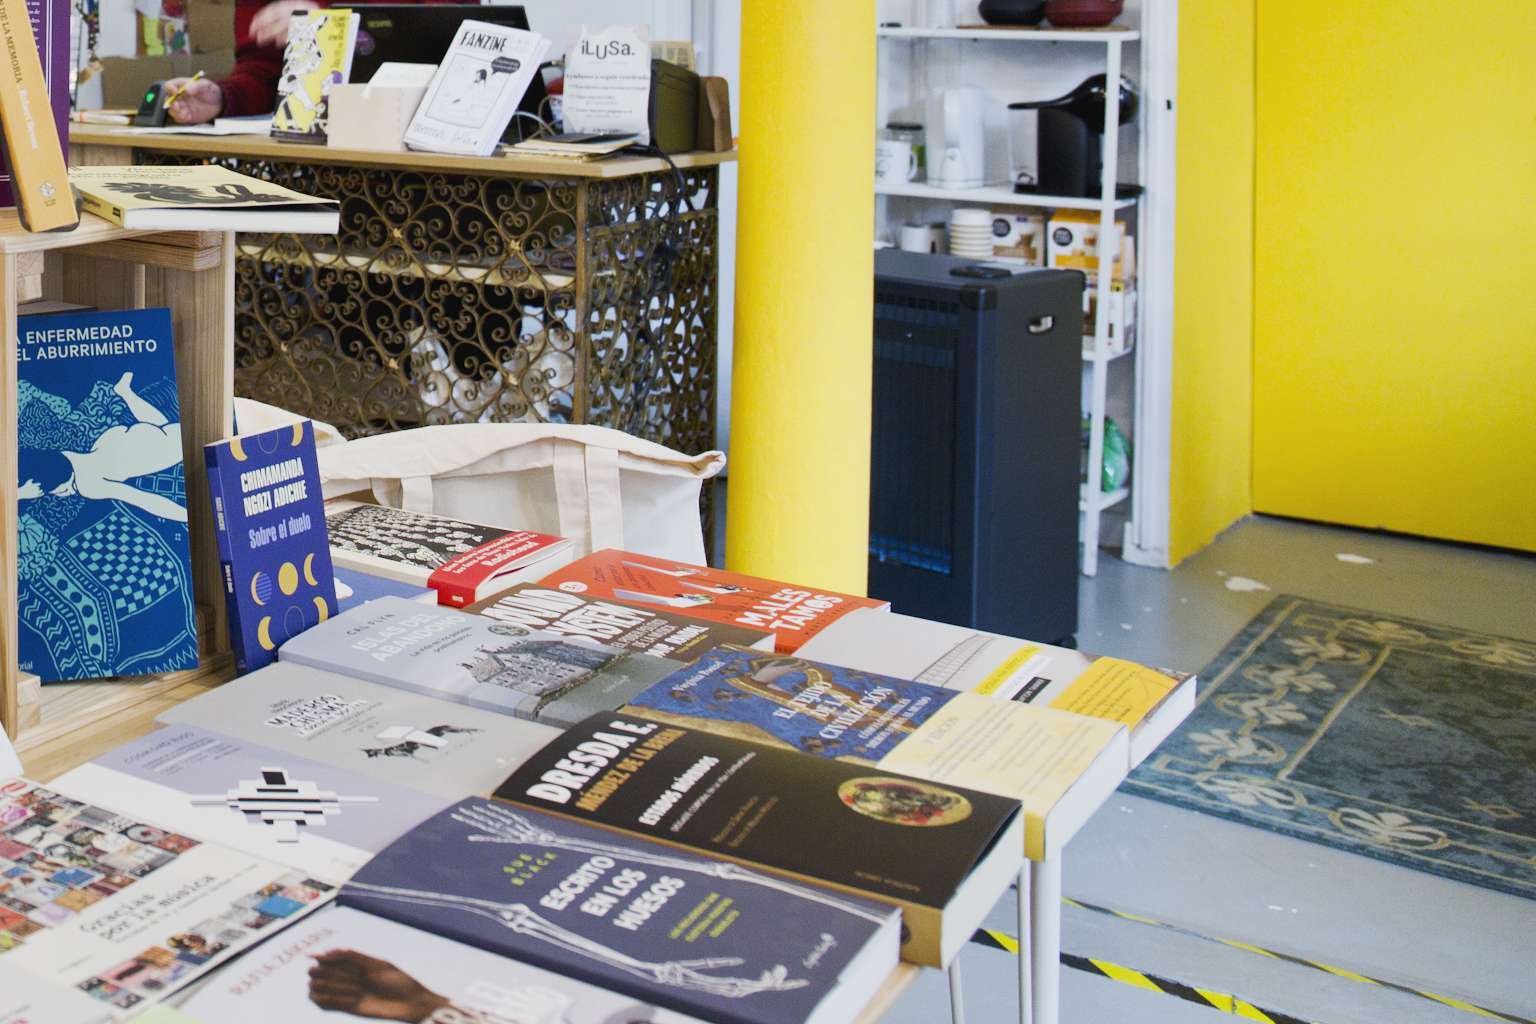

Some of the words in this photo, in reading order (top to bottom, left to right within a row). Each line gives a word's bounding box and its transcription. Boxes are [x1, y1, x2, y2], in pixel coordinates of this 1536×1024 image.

[2, 21, 12, 36] LA
[460, 31, 508, 53] FANZINE
[5, 36, 23, 84] MEMORIA
[15, 344, 31, 362] EL
[36, 339, 157, 361] ABURRIMIENTO
[26, 324, 133, 344] ENFERMEDAD
[240, 457, 305, 493] CHIMAMANDA
[243, 487, 272, 517] NGOZI
[272, 479, 307, 509] ADICHIE
[248, 523, 277, 550] Sobre
[278, 519, 287, 541] el
[288, 512, 312, 538] duelo
[479, 540, 540, 568] Radiohead
[736, 588, 812, 627] MALES
[352, 620, 408, 651] ISLAS
[406, 613, 440, 629] DEL
[370, 616, 467, 663] ABANDONO
[772, 707, 797, 720] EL
[789, 681, 834, 709] TEJIDO
[815, 704, 835, 721] DE
[830, 694, 853, 708] LA
[818, 685, 896, 740] CIVILIZACIÓN
[525, 730, 639, 804] DRESDA
[609, 720, 659, 736] E.
[622, 757, 645, 773] DE
[630, 747, 659, 762] LA
[574, 766, 632, 813] MÉNDEZ
[637, 788, 684, 827] ESTADOS
[670, 755, 720, 794] MÓRBIDOS
[503, 852, 533, 874] SUE
[511, 851, 557, 887] BLACK
[539, 855, 616, 912] ESCRITO
[580, 892, 619, 918] EN
[602, 867, 648, 897] LOS
[80, 892, 156, 933] Gracias
[99, 919, 131, 941] por
[137, 906, 157, 921] la
[157, 872, 216, 908] música
[612, 875, 686, 932] HUESOS
